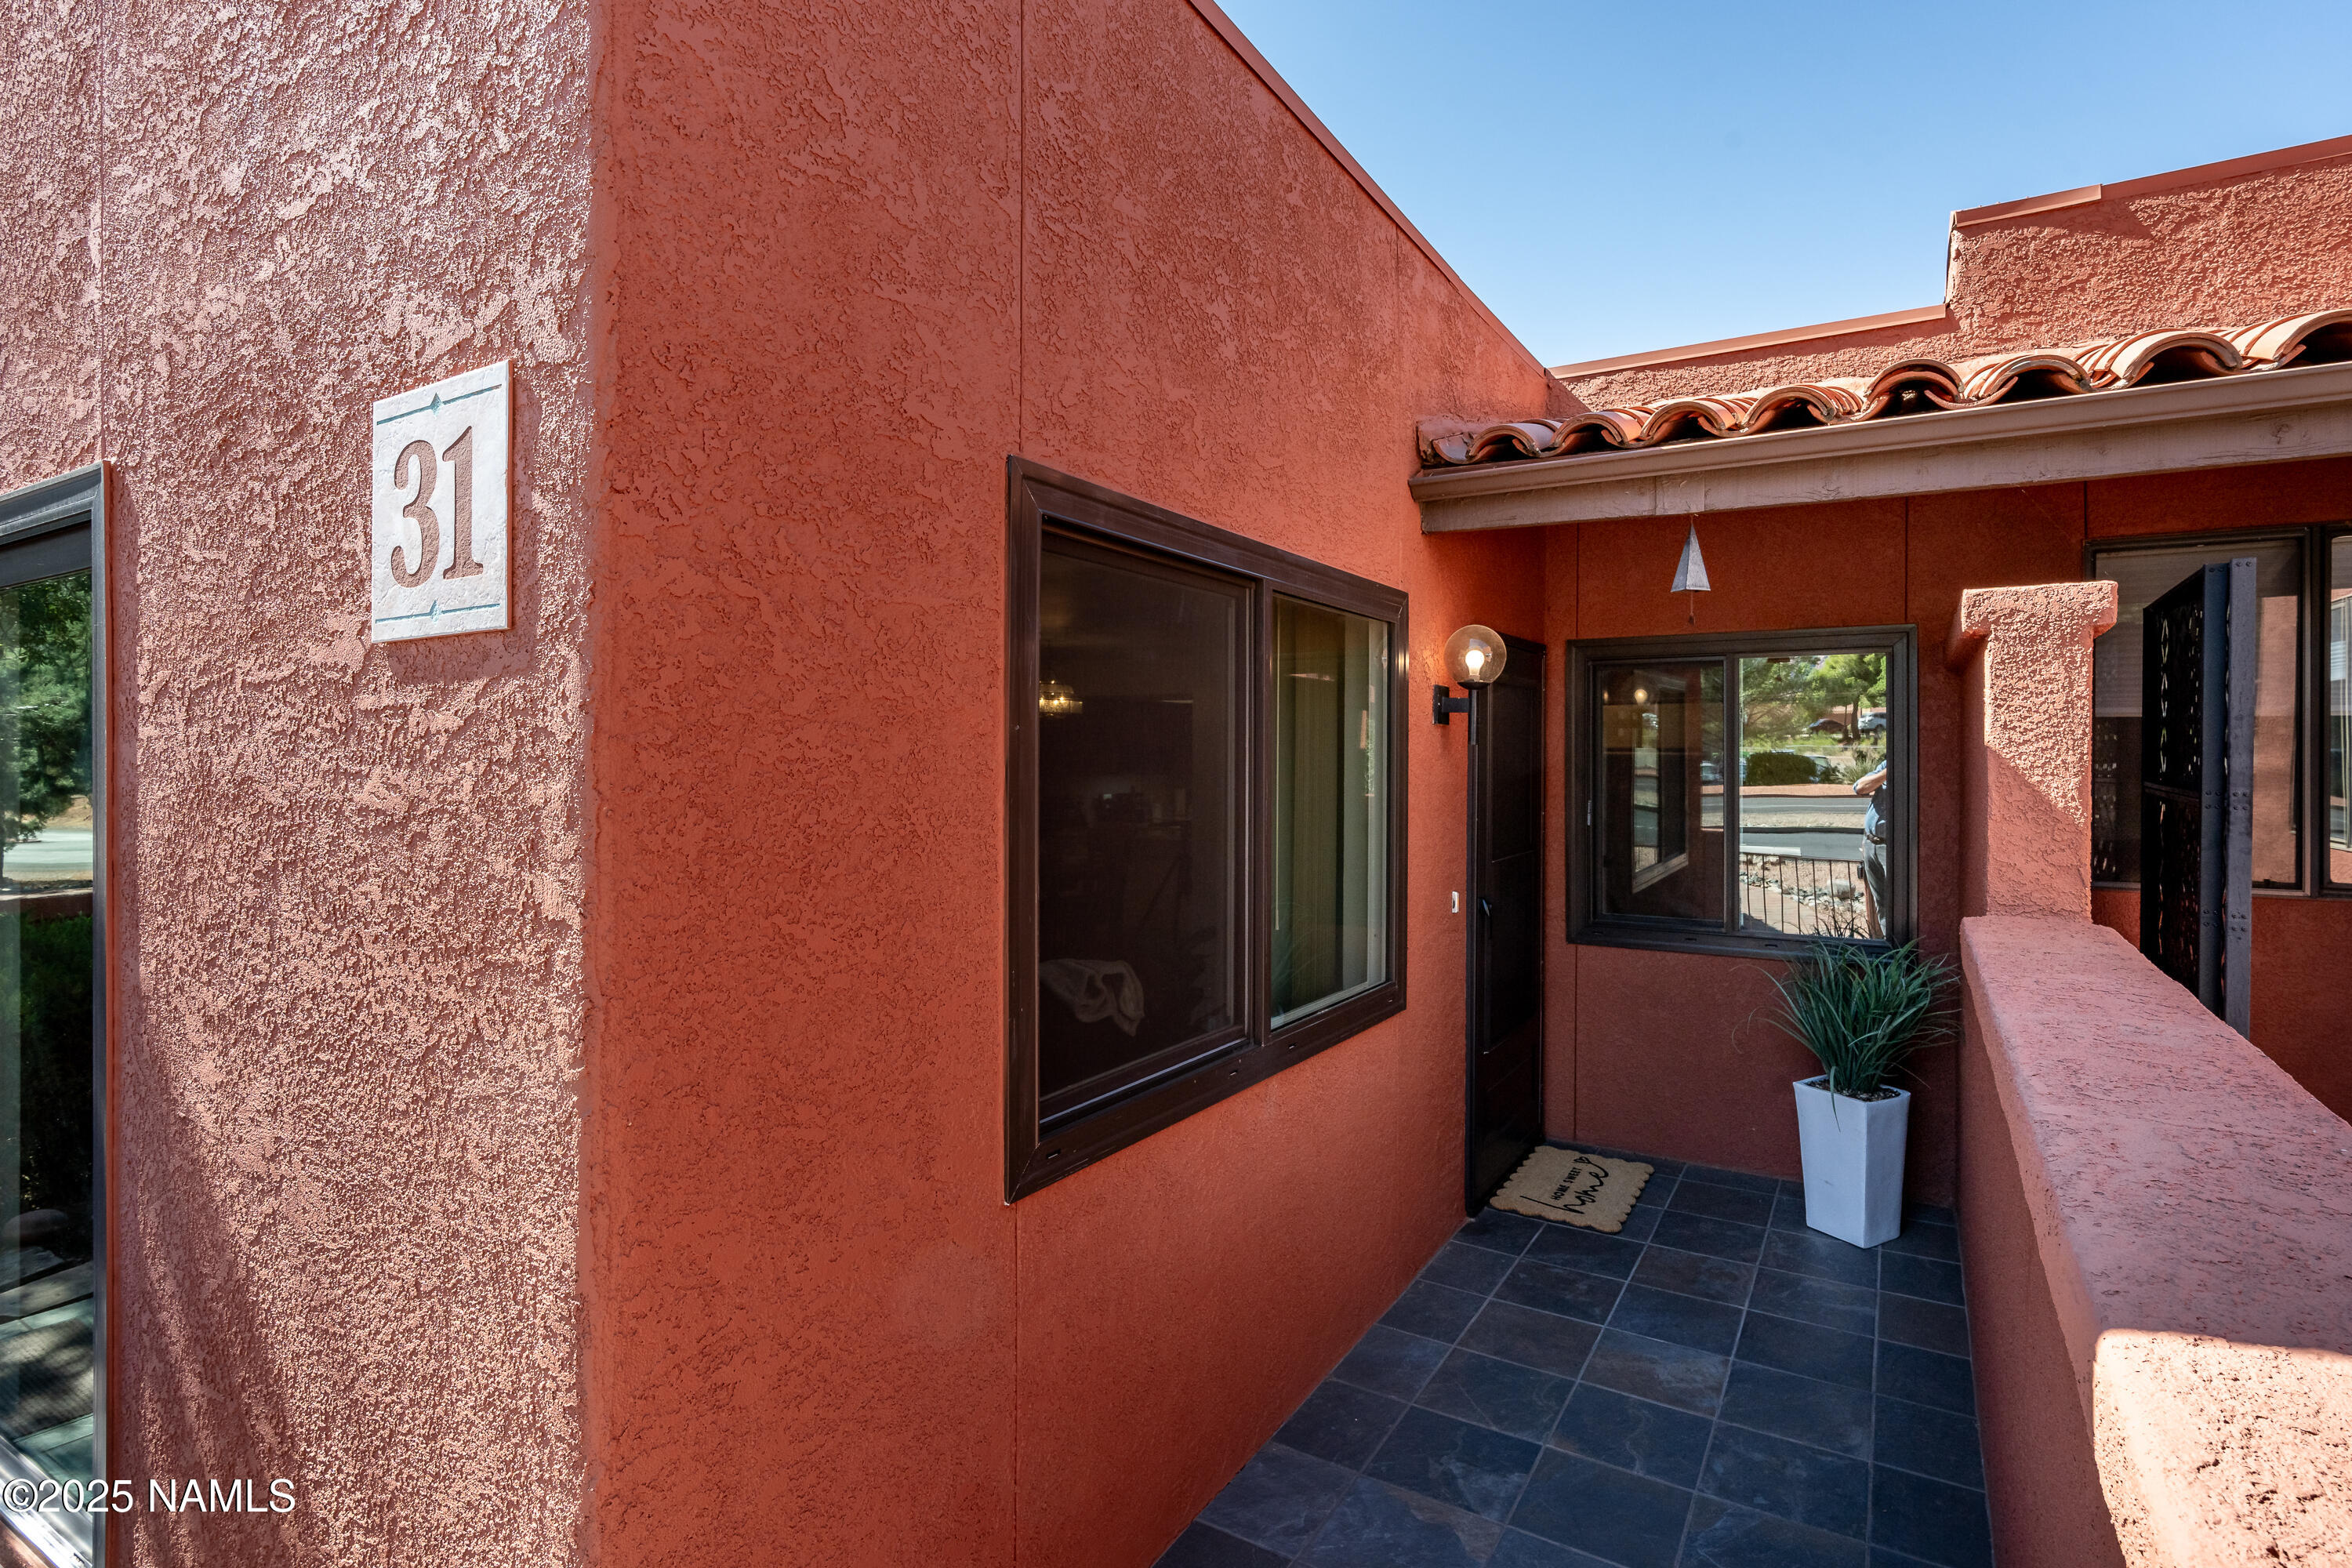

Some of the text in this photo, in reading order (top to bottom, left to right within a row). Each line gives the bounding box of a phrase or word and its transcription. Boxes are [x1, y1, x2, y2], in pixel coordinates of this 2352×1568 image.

[390, 426, 484, 588] 31
[1551, 1167, 1582, 1200] HOME SWEET
